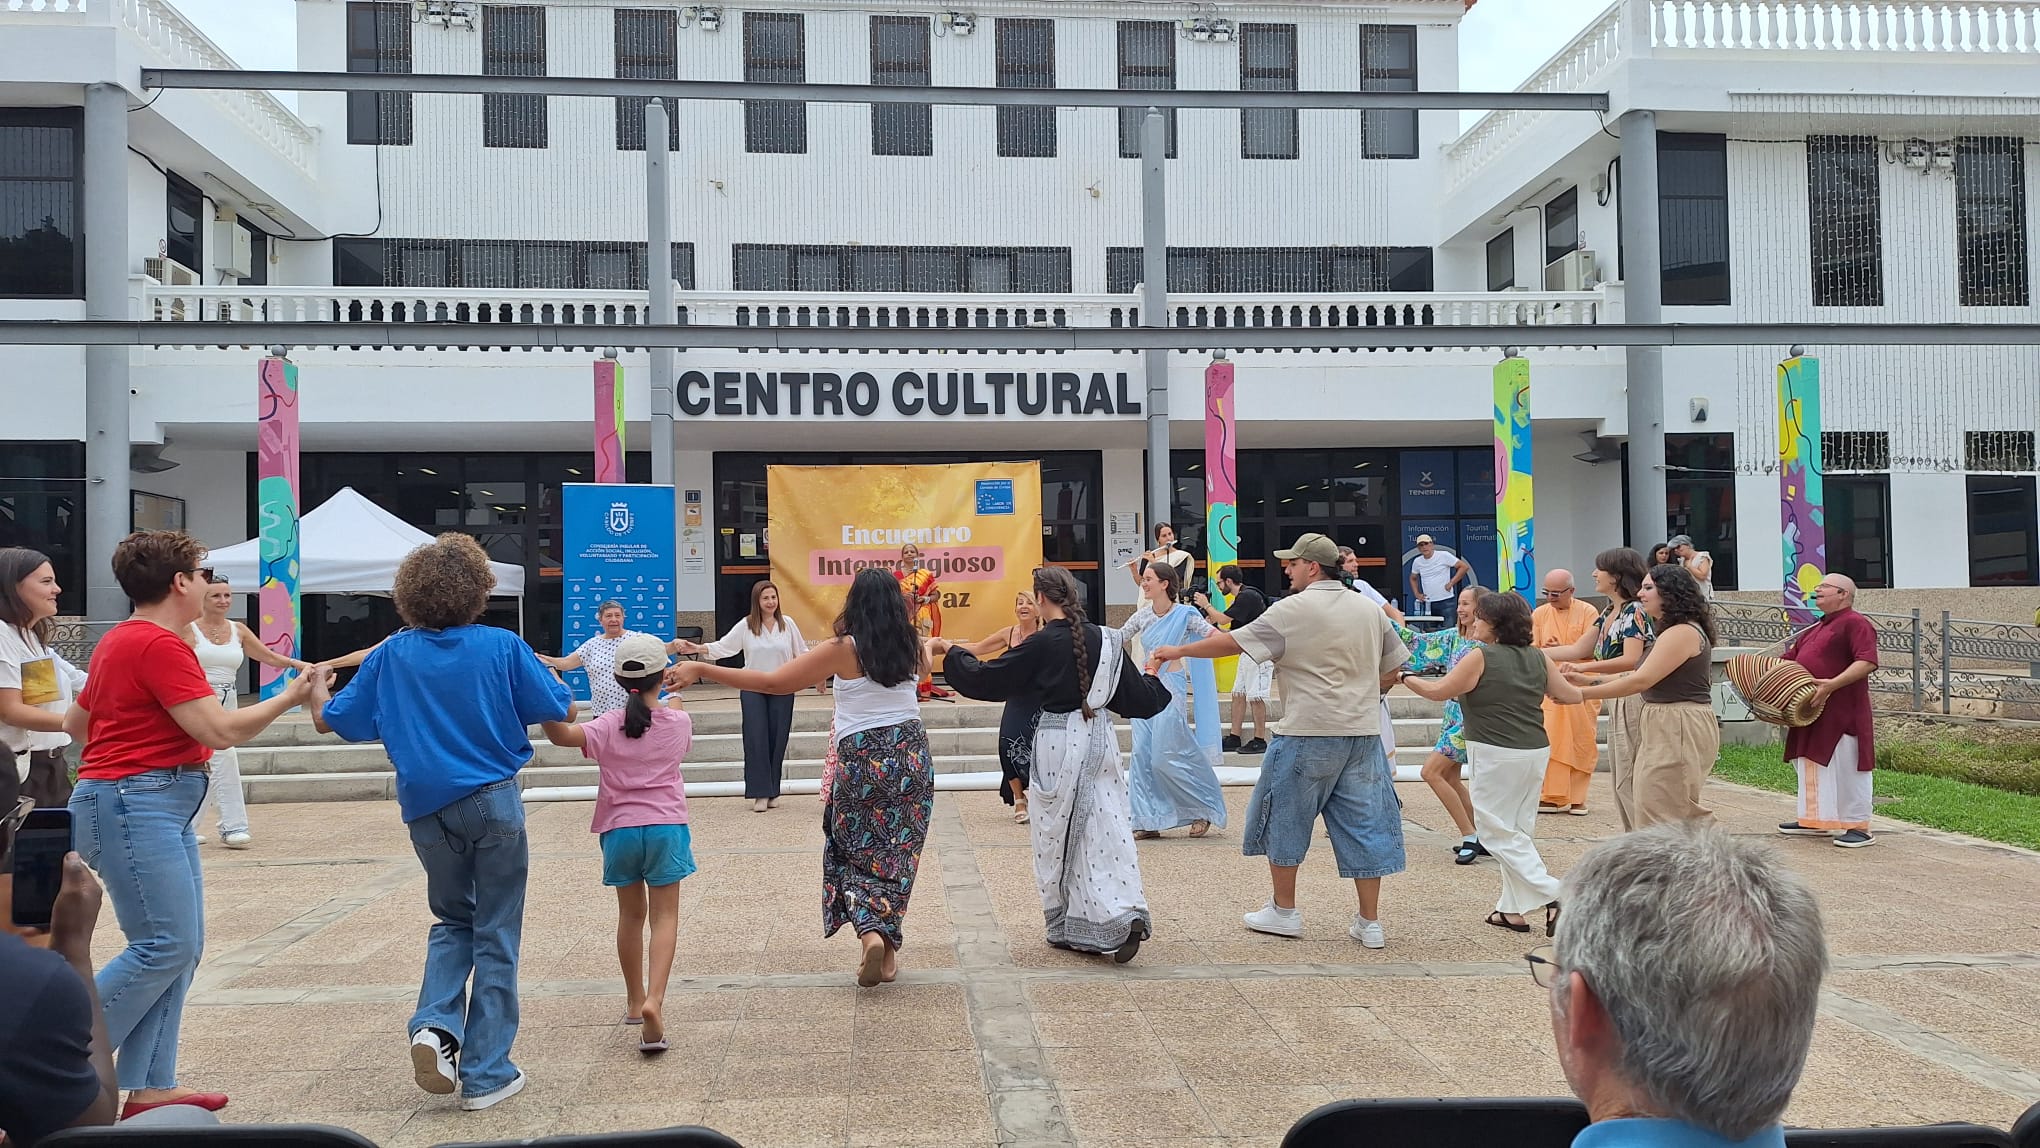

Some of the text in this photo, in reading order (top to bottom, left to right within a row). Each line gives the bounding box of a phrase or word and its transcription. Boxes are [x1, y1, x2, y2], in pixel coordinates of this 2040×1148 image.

[676, 371, 1142, 416] CENTRO CULTURAL
[842, 524, 972, 545] Encuentro
[818, 552, 996, 578] Interreigioso
